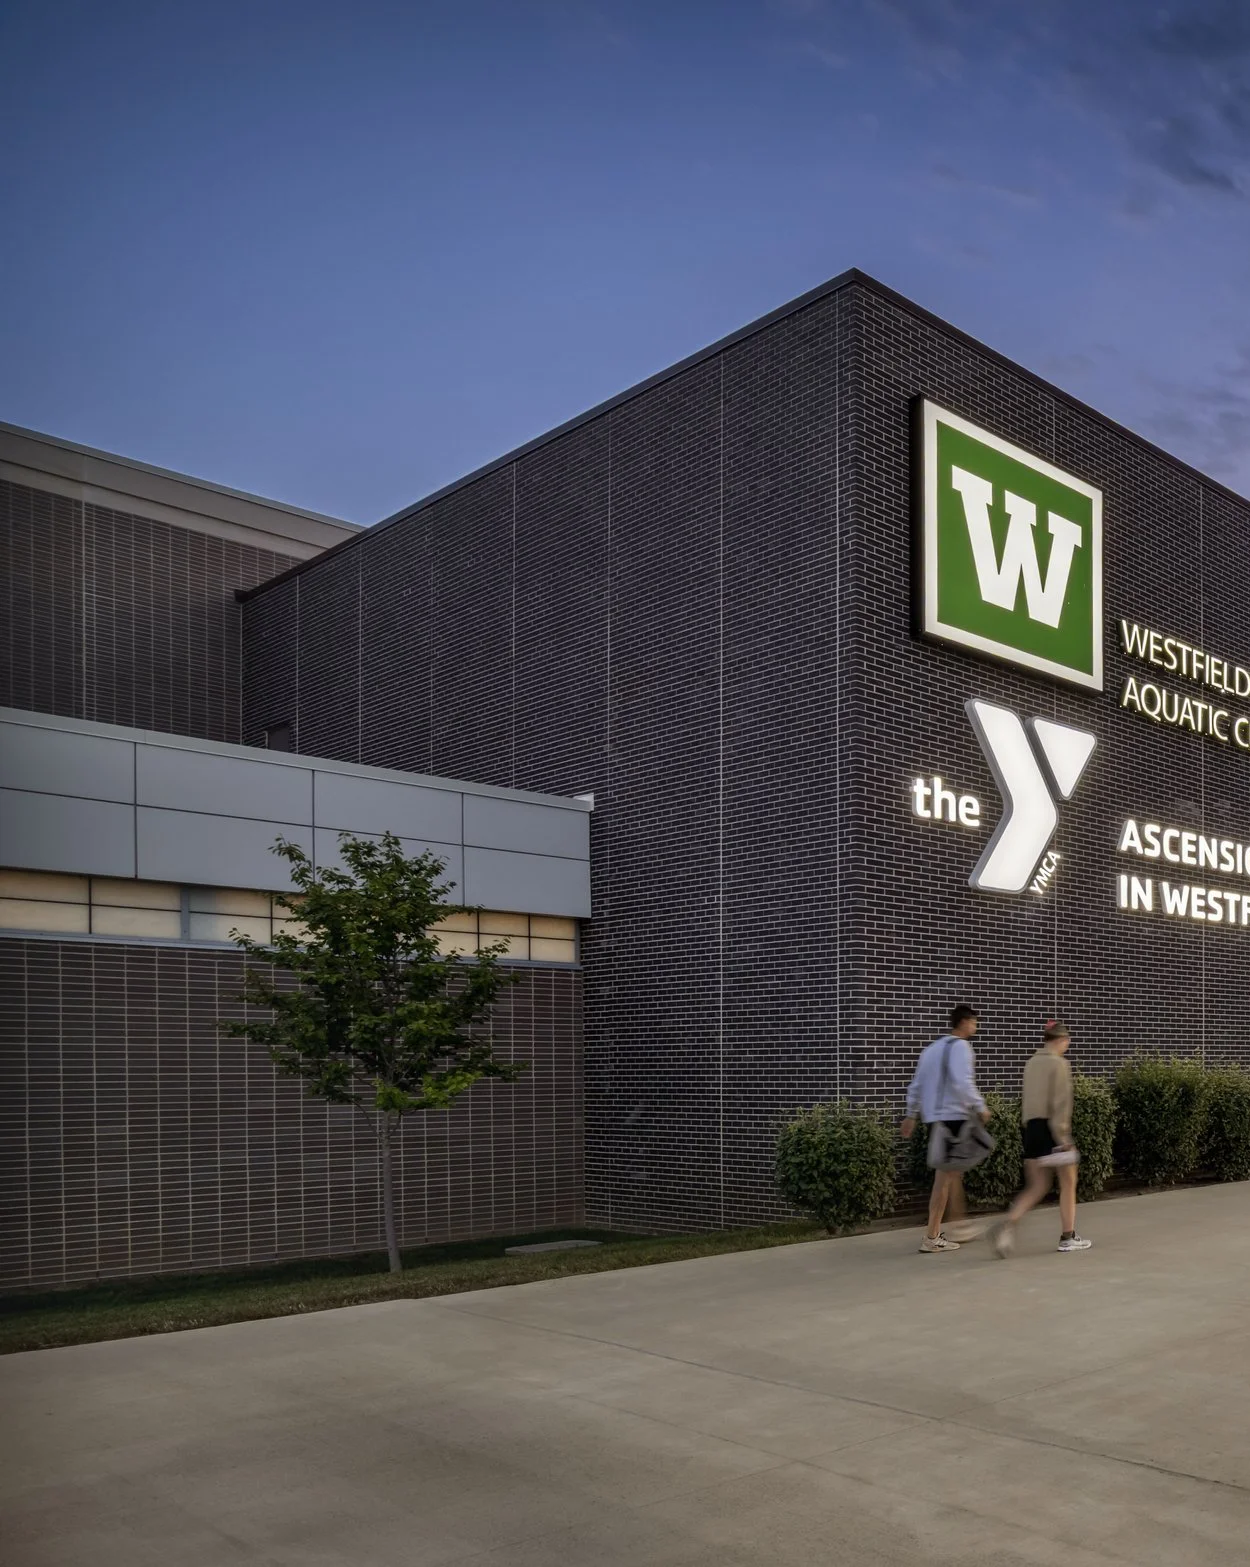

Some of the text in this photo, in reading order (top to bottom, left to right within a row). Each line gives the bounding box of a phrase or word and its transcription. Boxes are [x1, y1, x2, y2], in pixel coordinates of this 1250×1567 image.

[952, 464, 1082, 629] W
[1122, 677, 1229, 741] AQUATIC
[912, 698, 1097, 894] the Y
[1029, 850, 1061, 895] YMCA
[1117, 874, 1153, 911] IN
